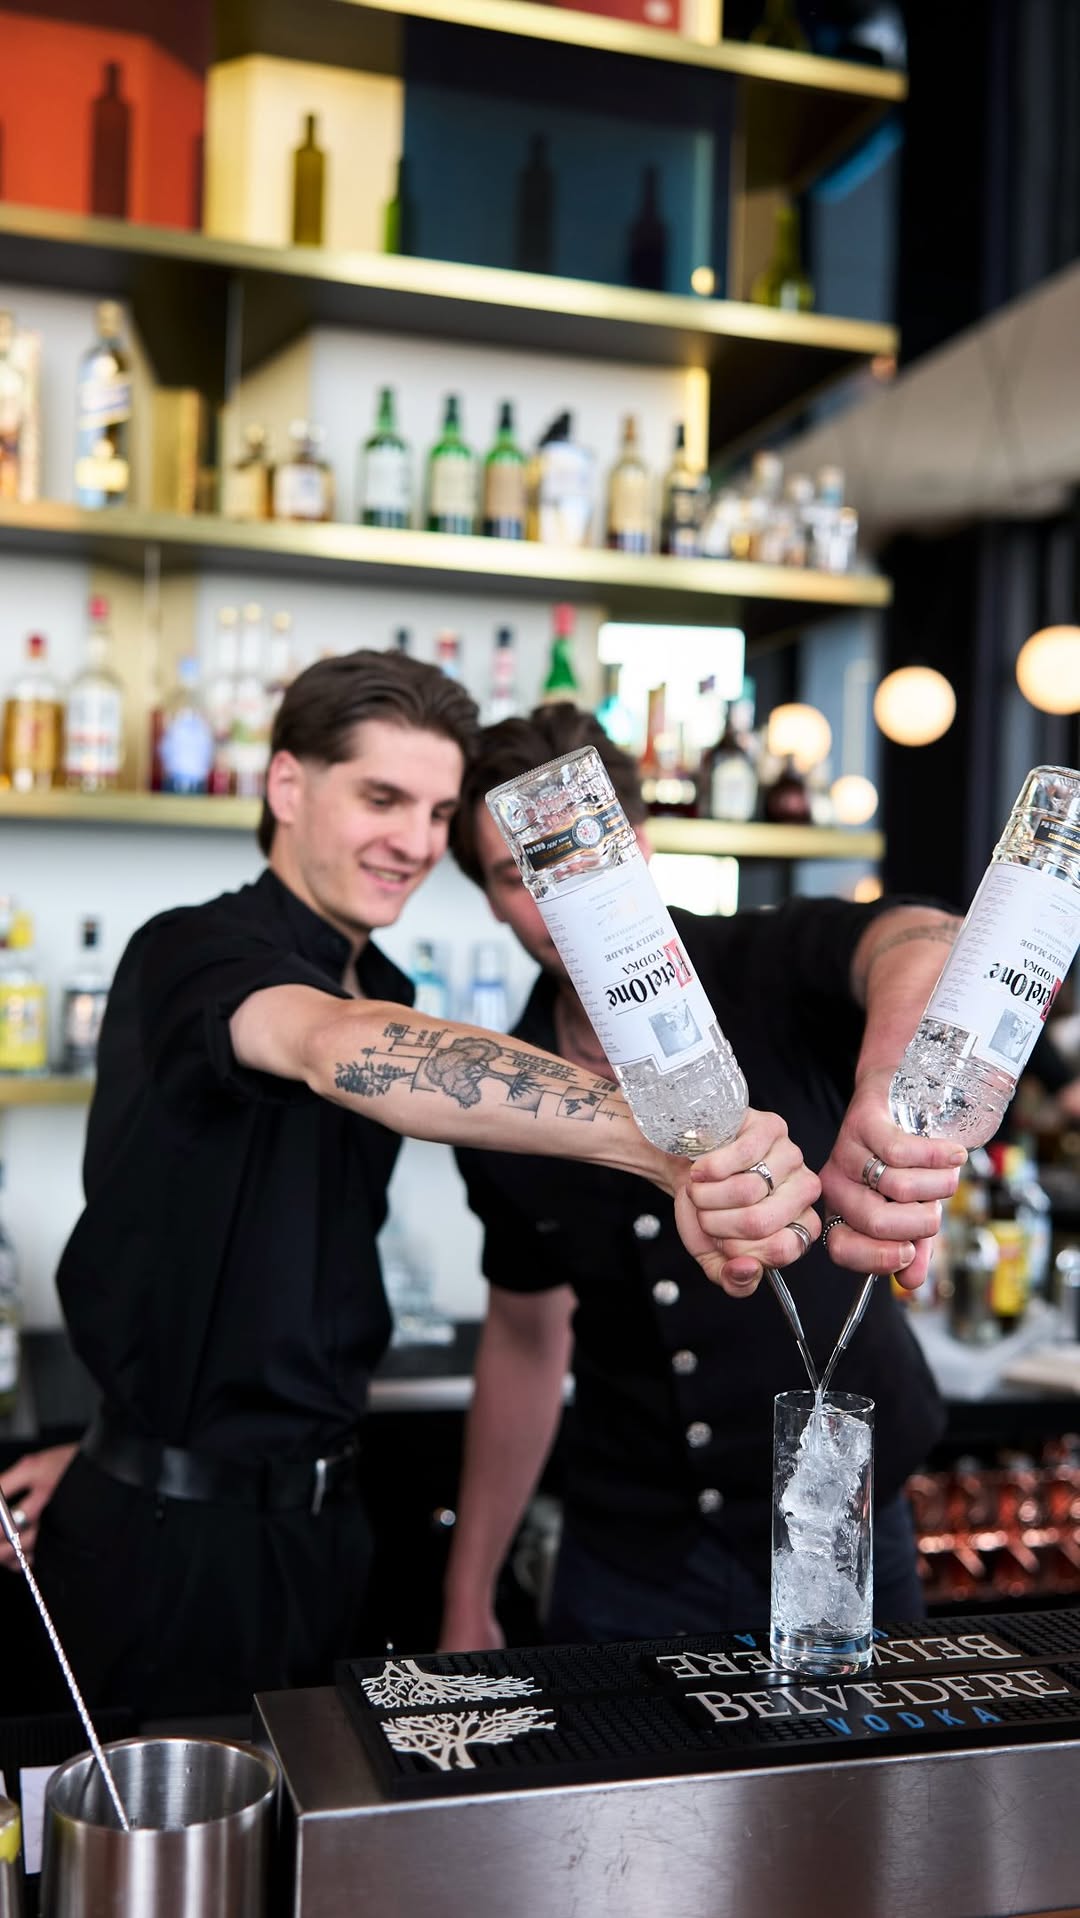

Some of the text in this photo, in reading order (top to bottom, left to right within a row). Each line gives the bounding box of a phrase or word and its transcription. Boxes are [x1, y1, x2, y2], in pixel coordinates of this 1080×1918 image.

[636, 927, 665, 948] FAMILY
[1020, 939, 1048, 958] MADE
[605, 944, 635, 962] MADE
[622, 949, 664, 975] VODKA
[645, 941, 692, 996] Ketel
[989, 962, 1028, 997] One
[1023, 958, 1056, 985] VODKA
[605, 978, 648, 1007] One
[656, 1634, 1022, 1679] BELVERE
[685, 1670, 1070, 1723] BELVEDERE
[825, 1706, 1003, 1736] VODKA
